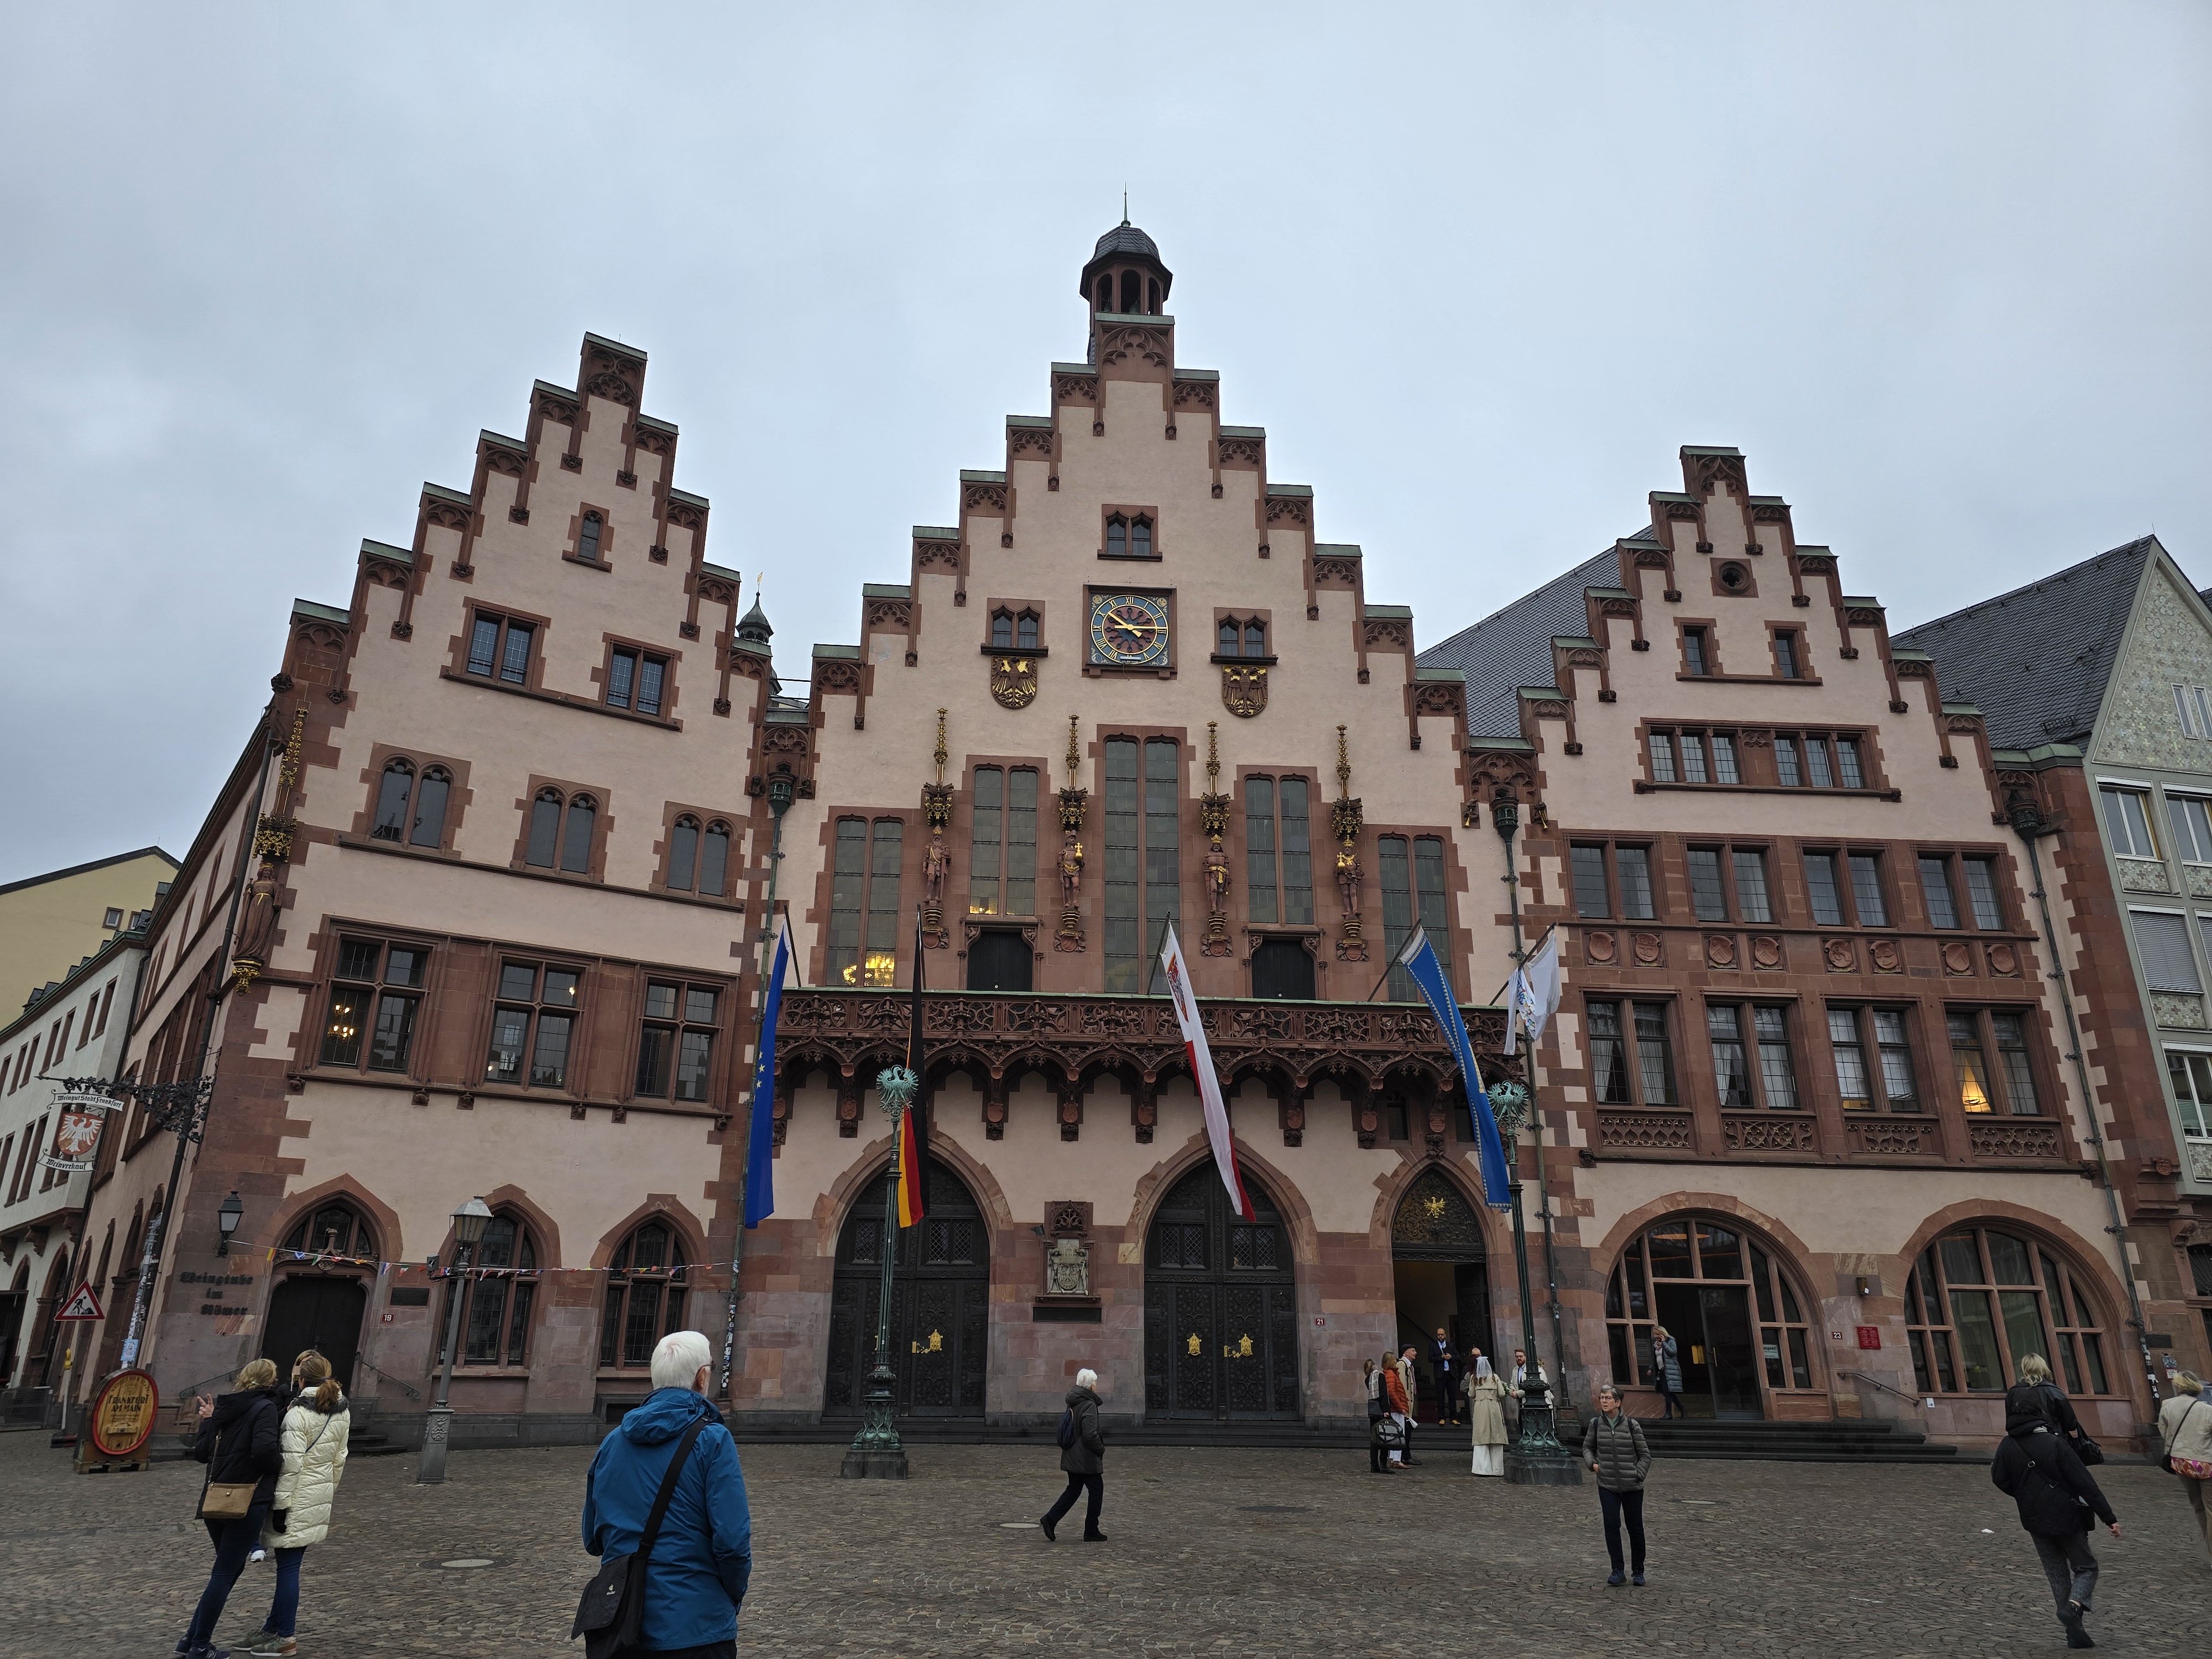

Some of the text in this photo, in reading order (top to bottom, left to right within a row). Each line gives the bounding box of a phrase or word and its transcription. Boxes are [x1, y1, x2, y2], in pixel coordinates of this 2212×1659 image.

[1108, 599, 1118, 608] XI
[95, 1097, 122, 1108] Frankfurt
[45, 1158, 87, 1171] Weinverkauf
[206, 1287, 223, 1299] im
[201, 1304, 248, 1316] Römer
[108, 1394, 150, 1404] FRANKFURT
